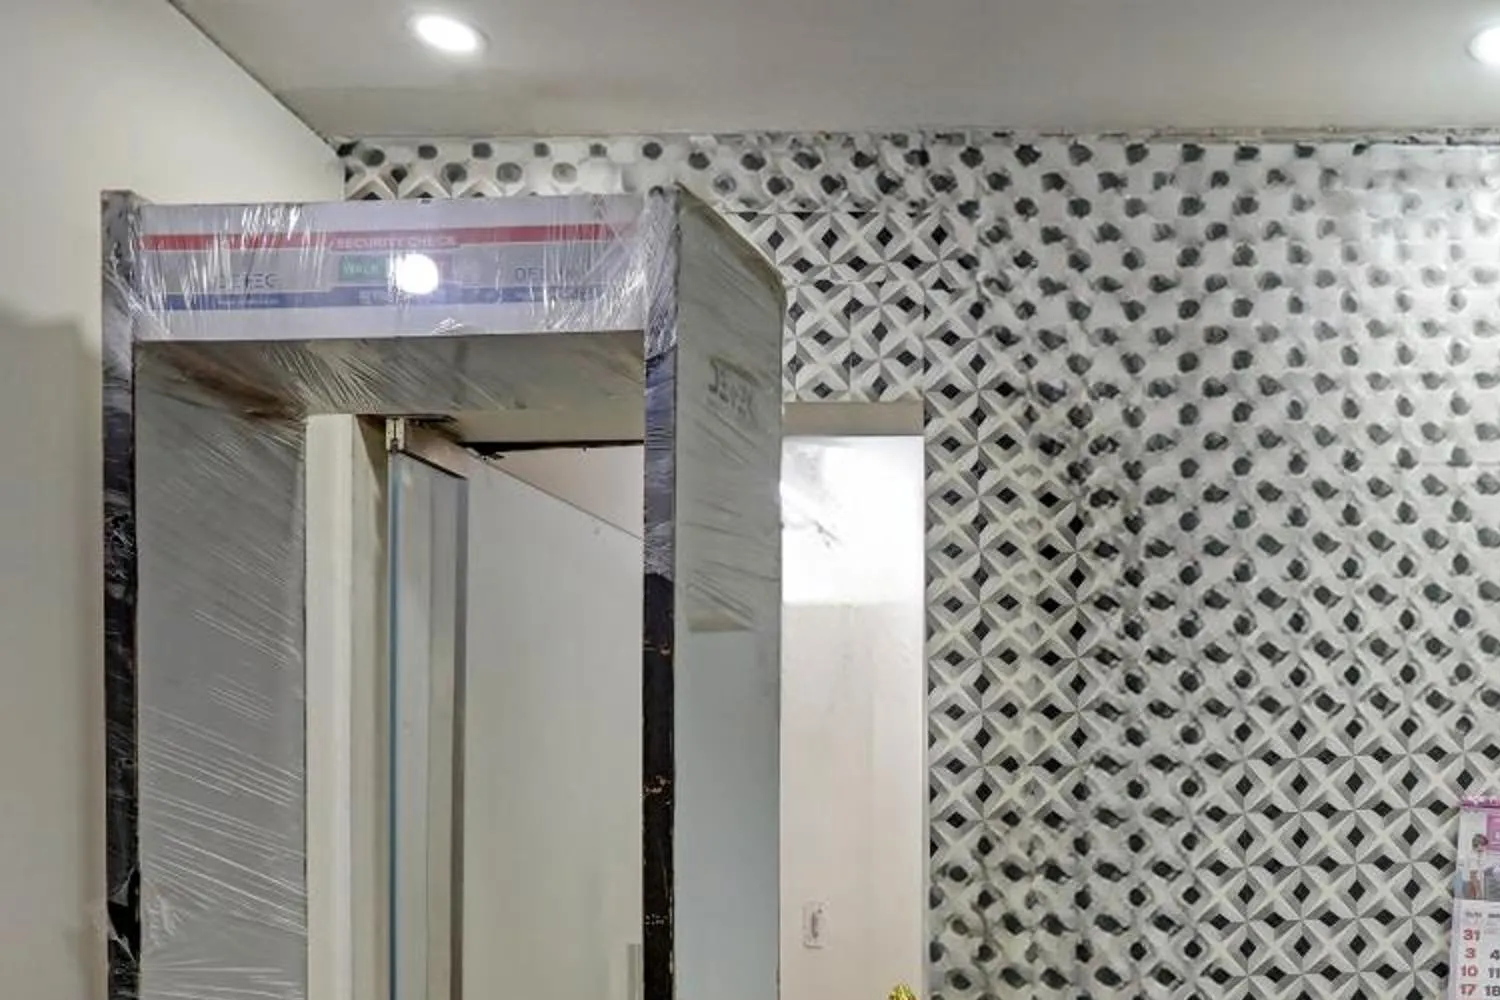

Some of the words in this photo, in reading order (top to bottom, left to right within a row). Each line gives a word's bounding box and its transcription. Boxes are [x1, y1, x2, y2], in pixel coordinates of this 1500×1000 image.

[1463, 929, 1480, 941] 31
[1465, 948, 1476, 959] 3
[1490, 949, 1500, 961] 4
[1461, 965, 1478, 977] 10
[1488, 967, 1500, 978] 11
[1460, 984, 1476, 996] 17
